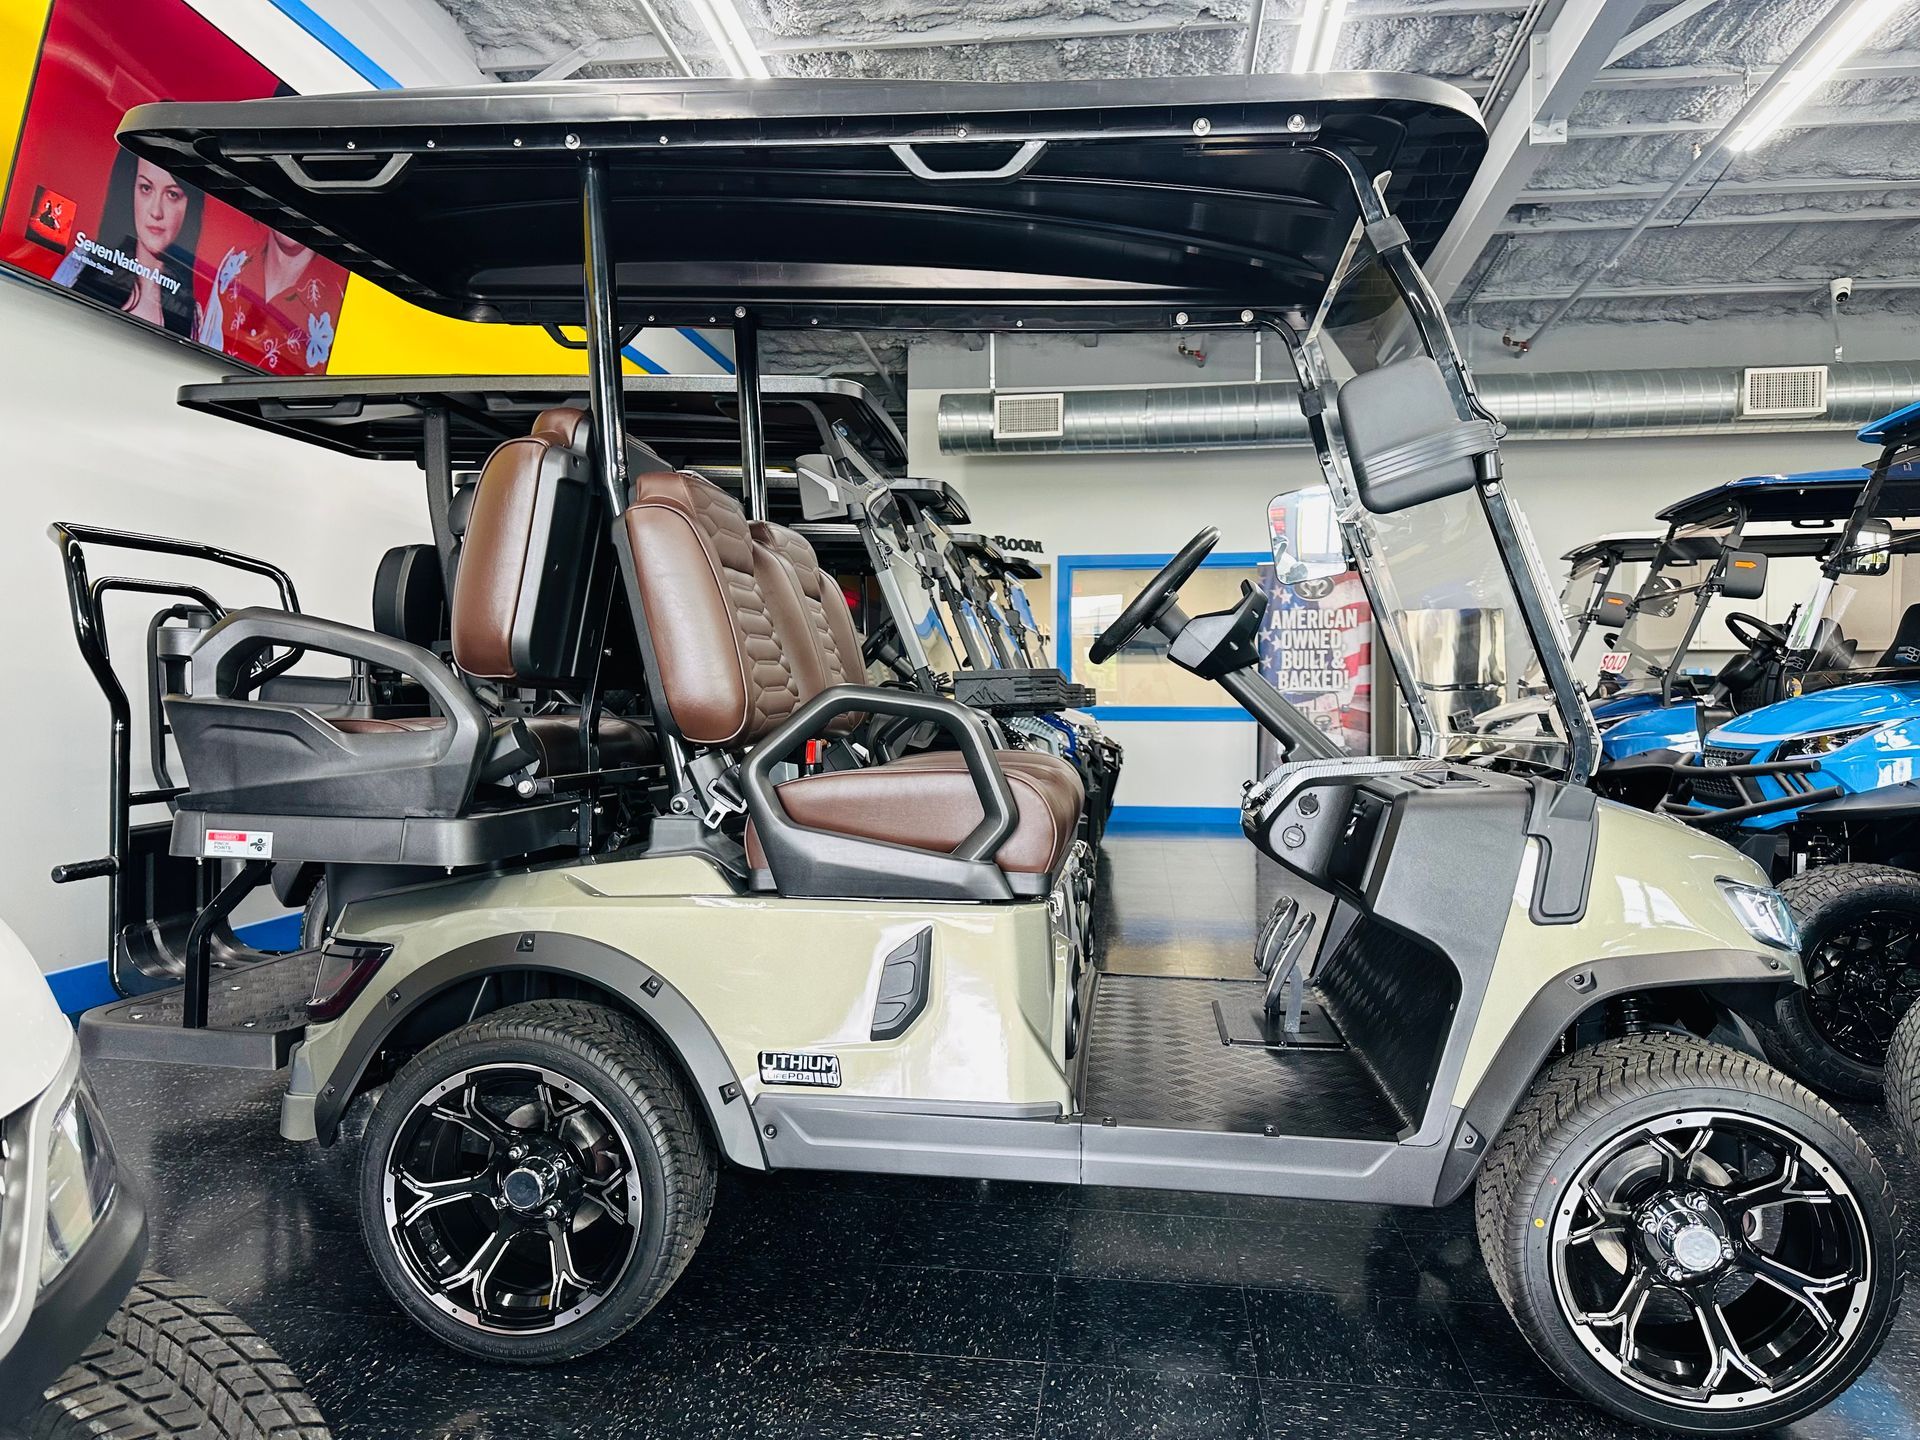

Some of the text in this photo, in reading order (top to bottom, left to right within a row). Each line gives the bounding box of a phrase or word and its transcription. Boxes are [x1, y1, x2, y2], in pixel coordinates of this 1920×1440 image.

[75, 231, 181, 294] Seven Nation Army
[995, 535, 1044, 553] ROOM
[1271, 608, 1358, 630] AMERICAN
[1281, 630, 1346, 650] OWNED,
[1281, 650, 1346, 670] BUILT &
[1601, 655, 1627, 670] SOLD
[1278, 670, 1349, 690] BACKED!
